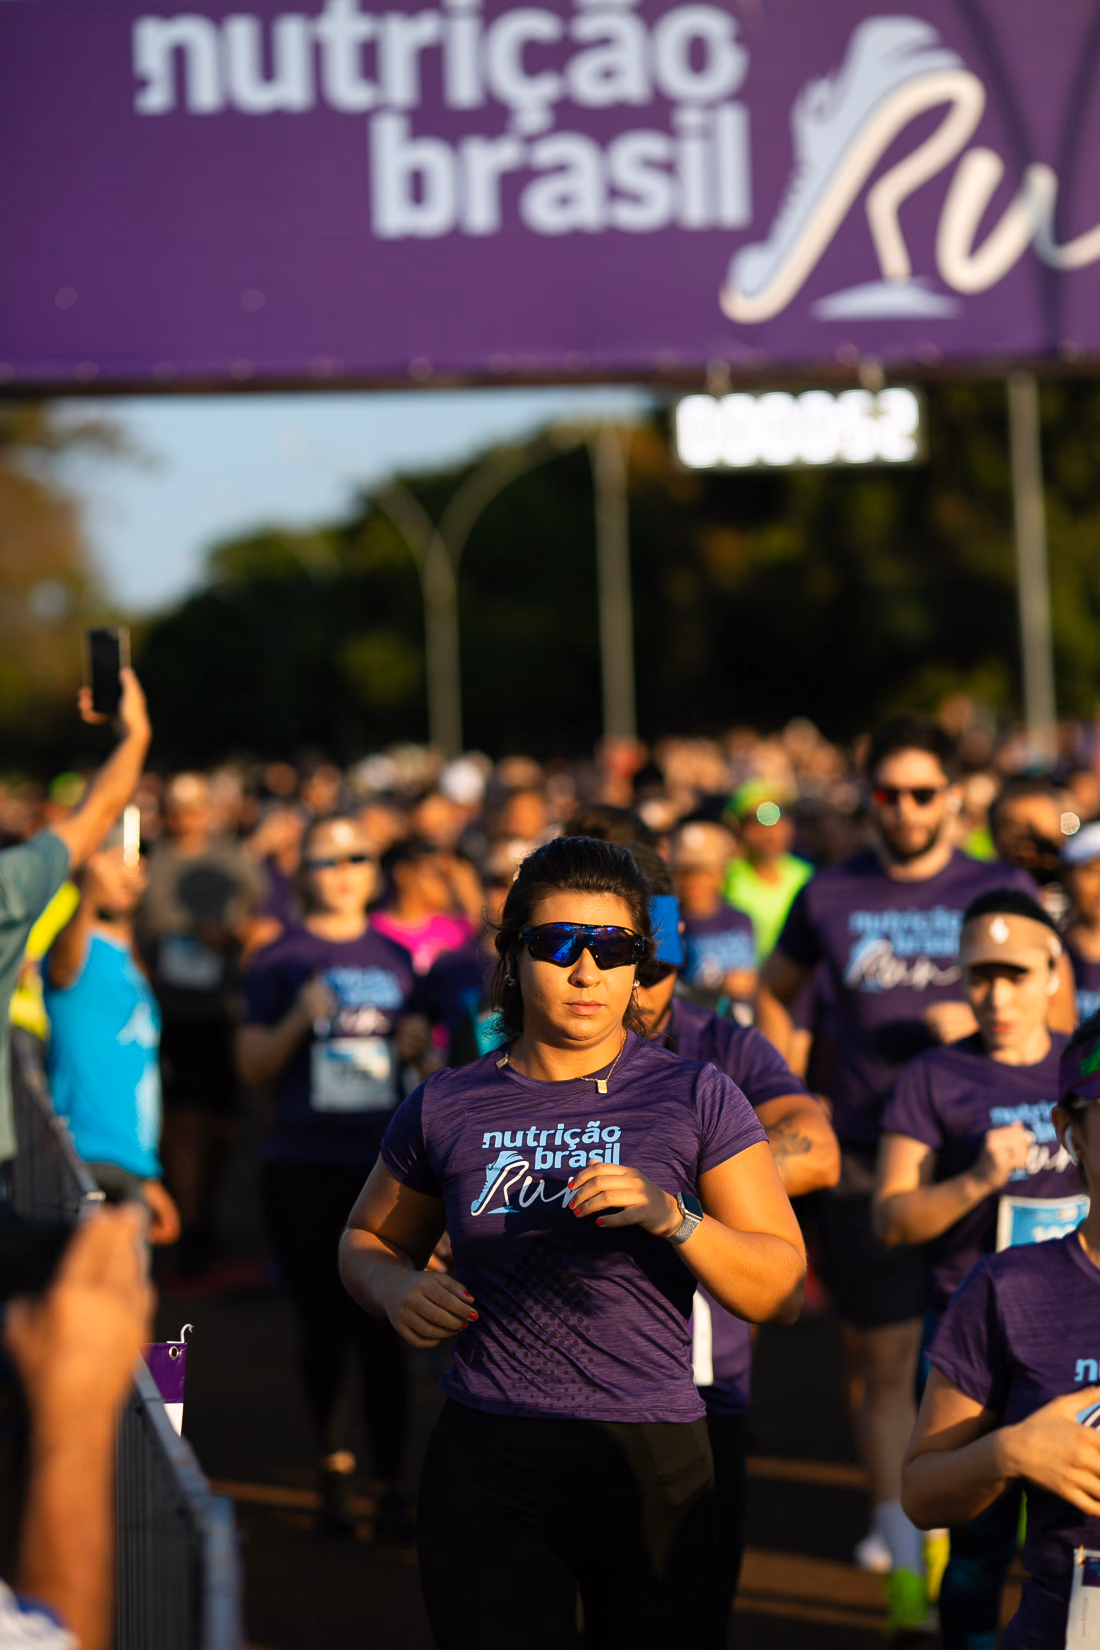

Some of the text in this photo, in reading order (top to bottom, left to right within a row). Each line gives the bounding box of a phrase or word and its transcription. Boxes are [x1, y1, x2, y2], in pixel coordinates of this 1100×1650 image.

[133, 0, 749, 135] nutrição
[369, 100, 751, 239] brasil
[718, 66, 1100, 325] Ru
[481, 1120, 621, 1151] nutrição
[534, 1142, 621, 1170] brasil
